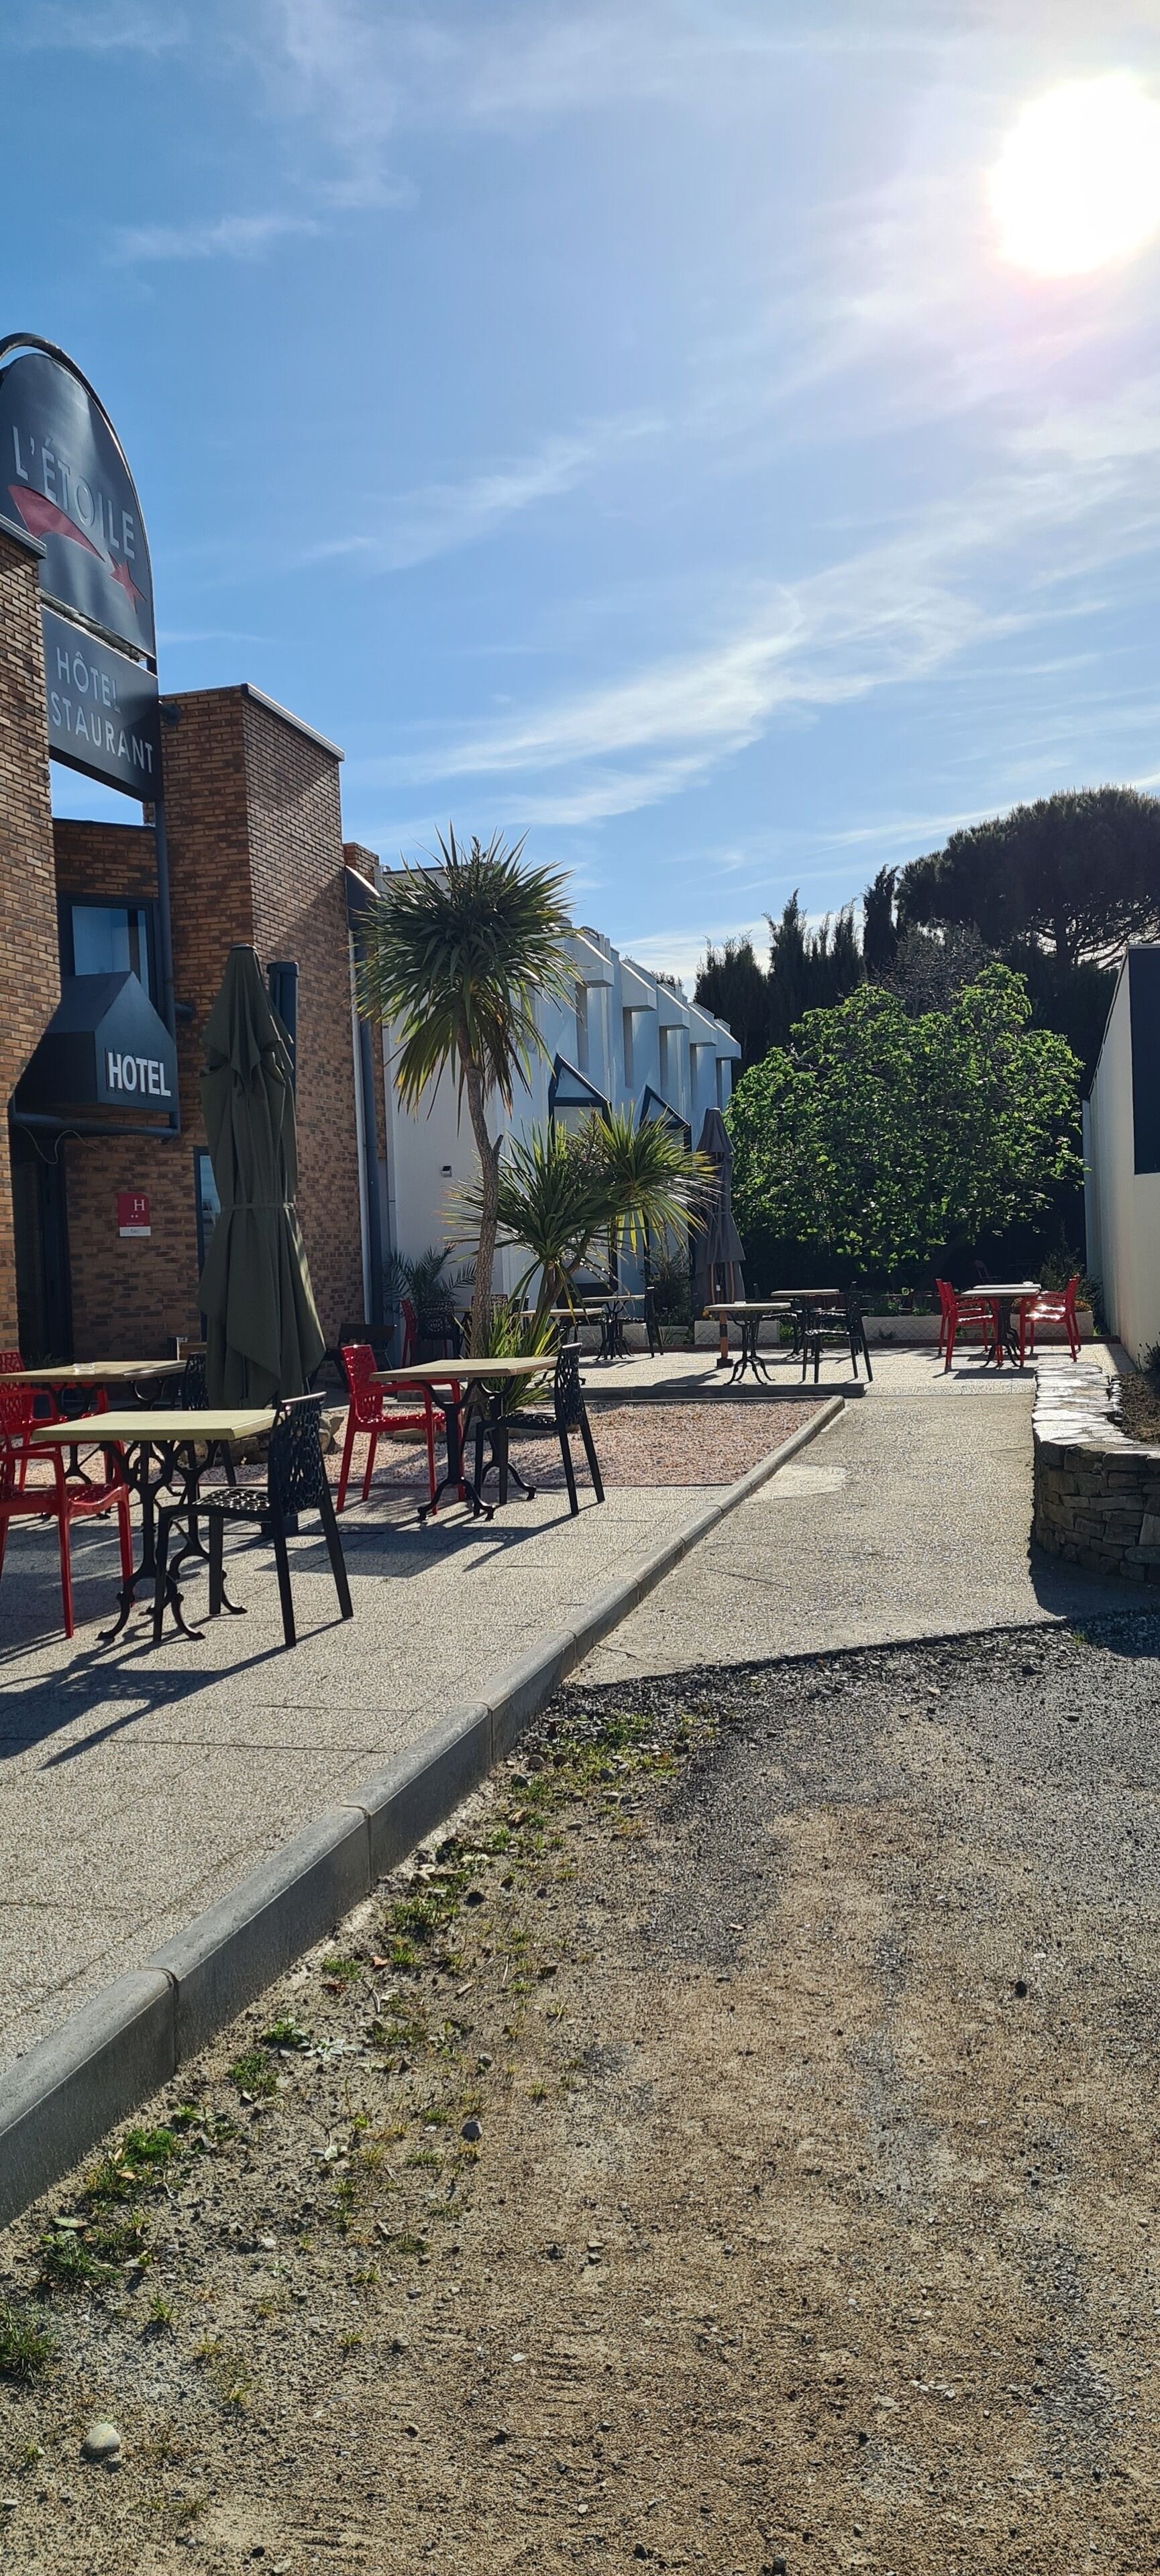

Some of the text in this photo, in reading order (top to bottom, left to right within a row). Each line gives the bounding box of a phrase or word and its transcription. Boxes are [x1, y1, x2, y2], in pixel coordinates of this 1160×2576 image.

[13, 425, 135, 559] L'ÉTOILE
[56, 647, 122, 714] HÔTEL
[48, 690, 153, 773] STAURANT
[107, 1051, 172, 1097] HOTEL
[134, 1199, 145, 1212] H
